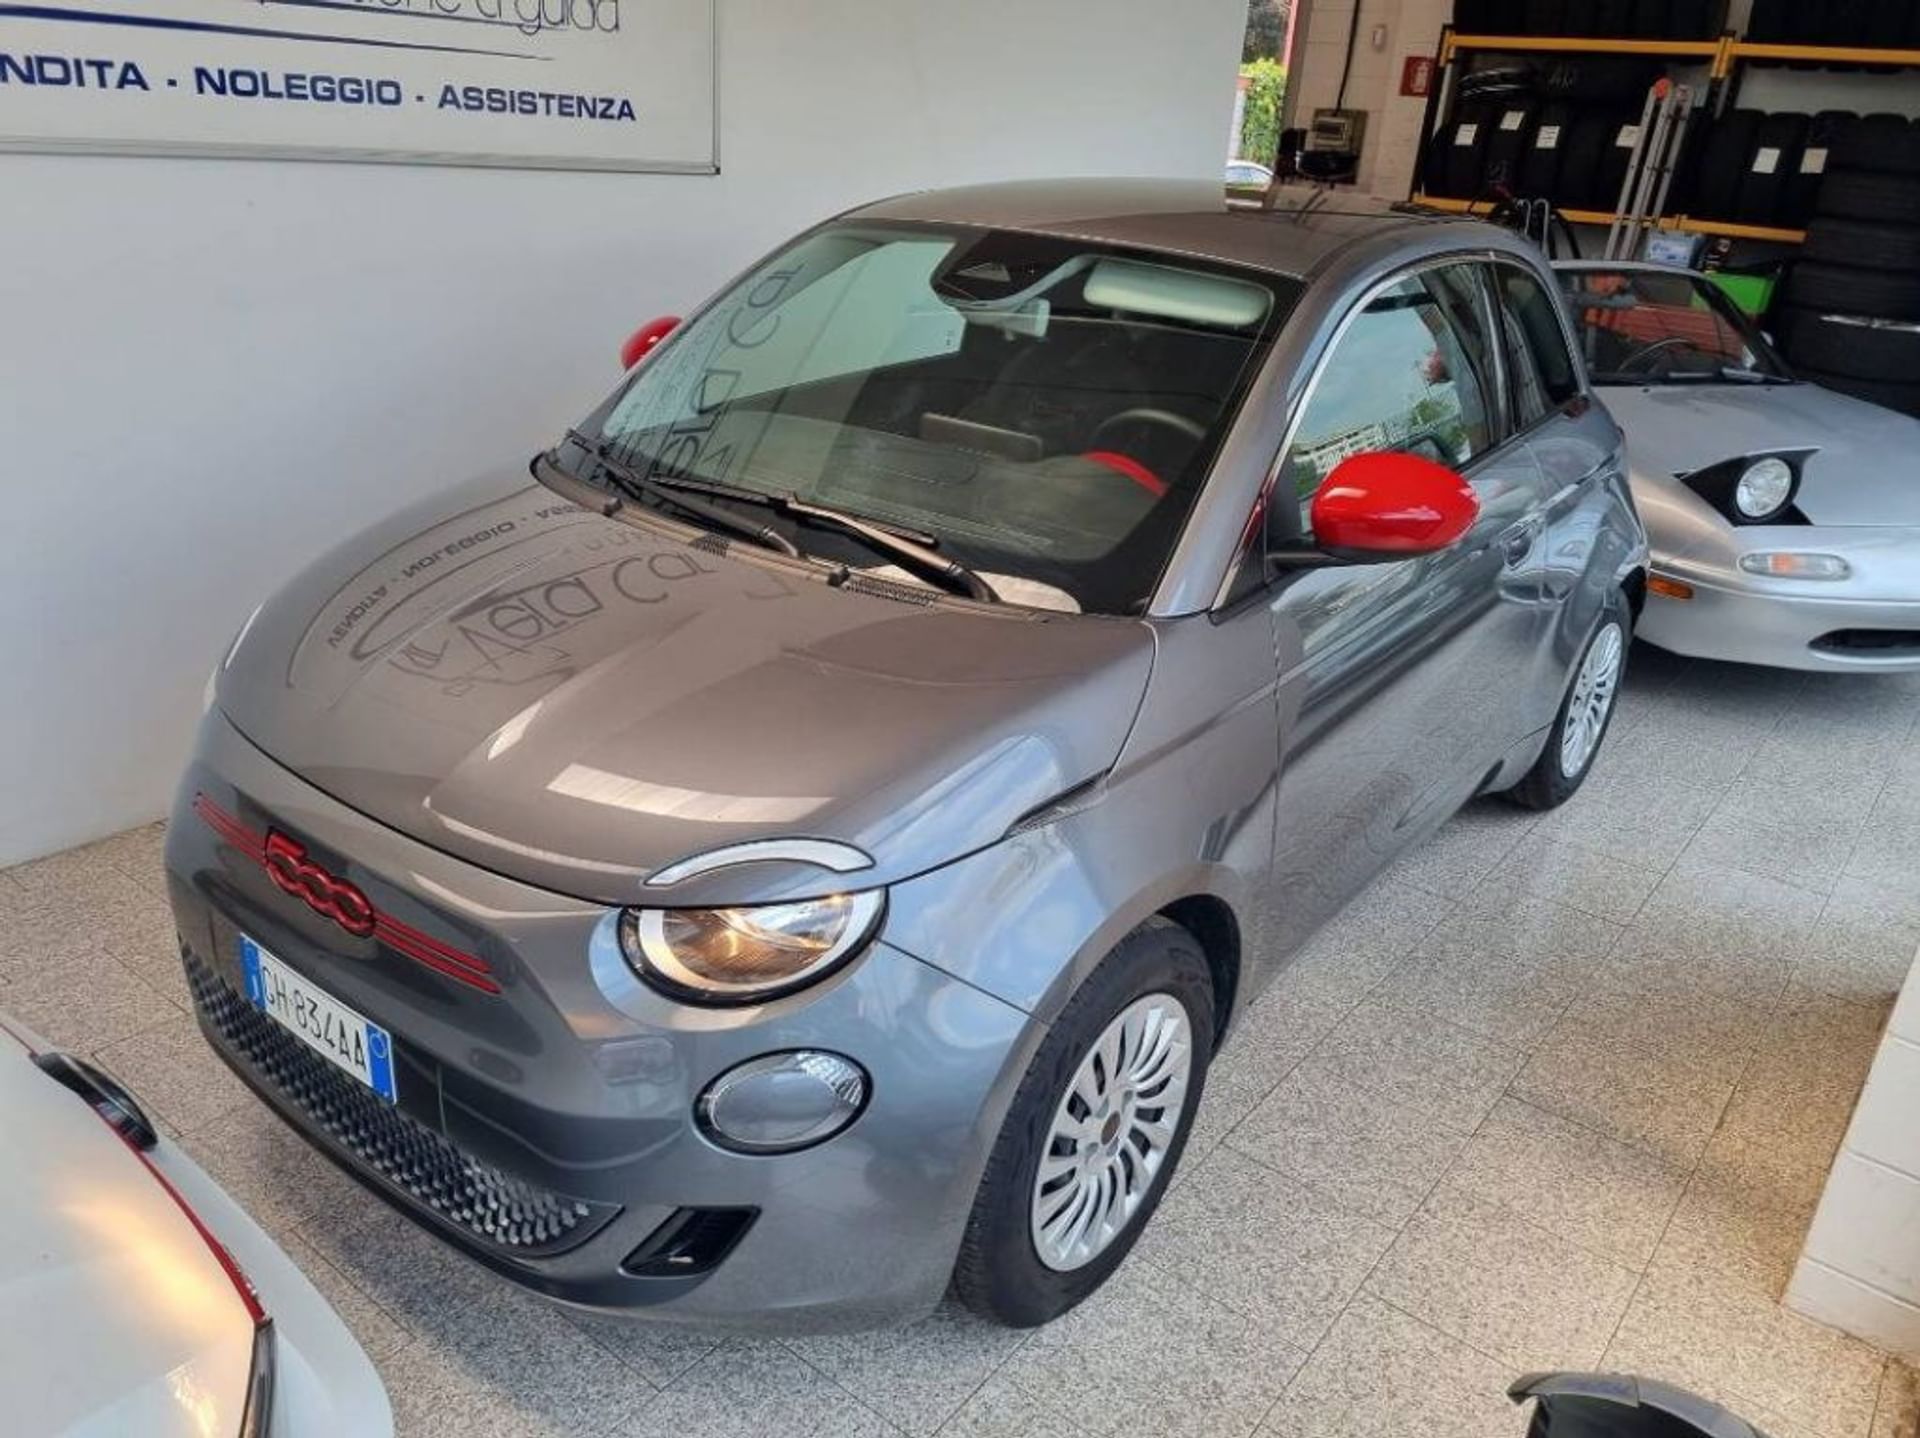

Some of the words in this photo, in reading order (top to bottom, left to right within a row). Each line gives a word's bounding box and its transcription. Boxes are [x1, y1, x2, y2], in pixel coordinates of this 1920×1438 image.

[194, 66, 402, 107] NOLEGGIO
[438, 84, 637, 122] ASSISTENZA
[264, 827, 377, 938] 500
